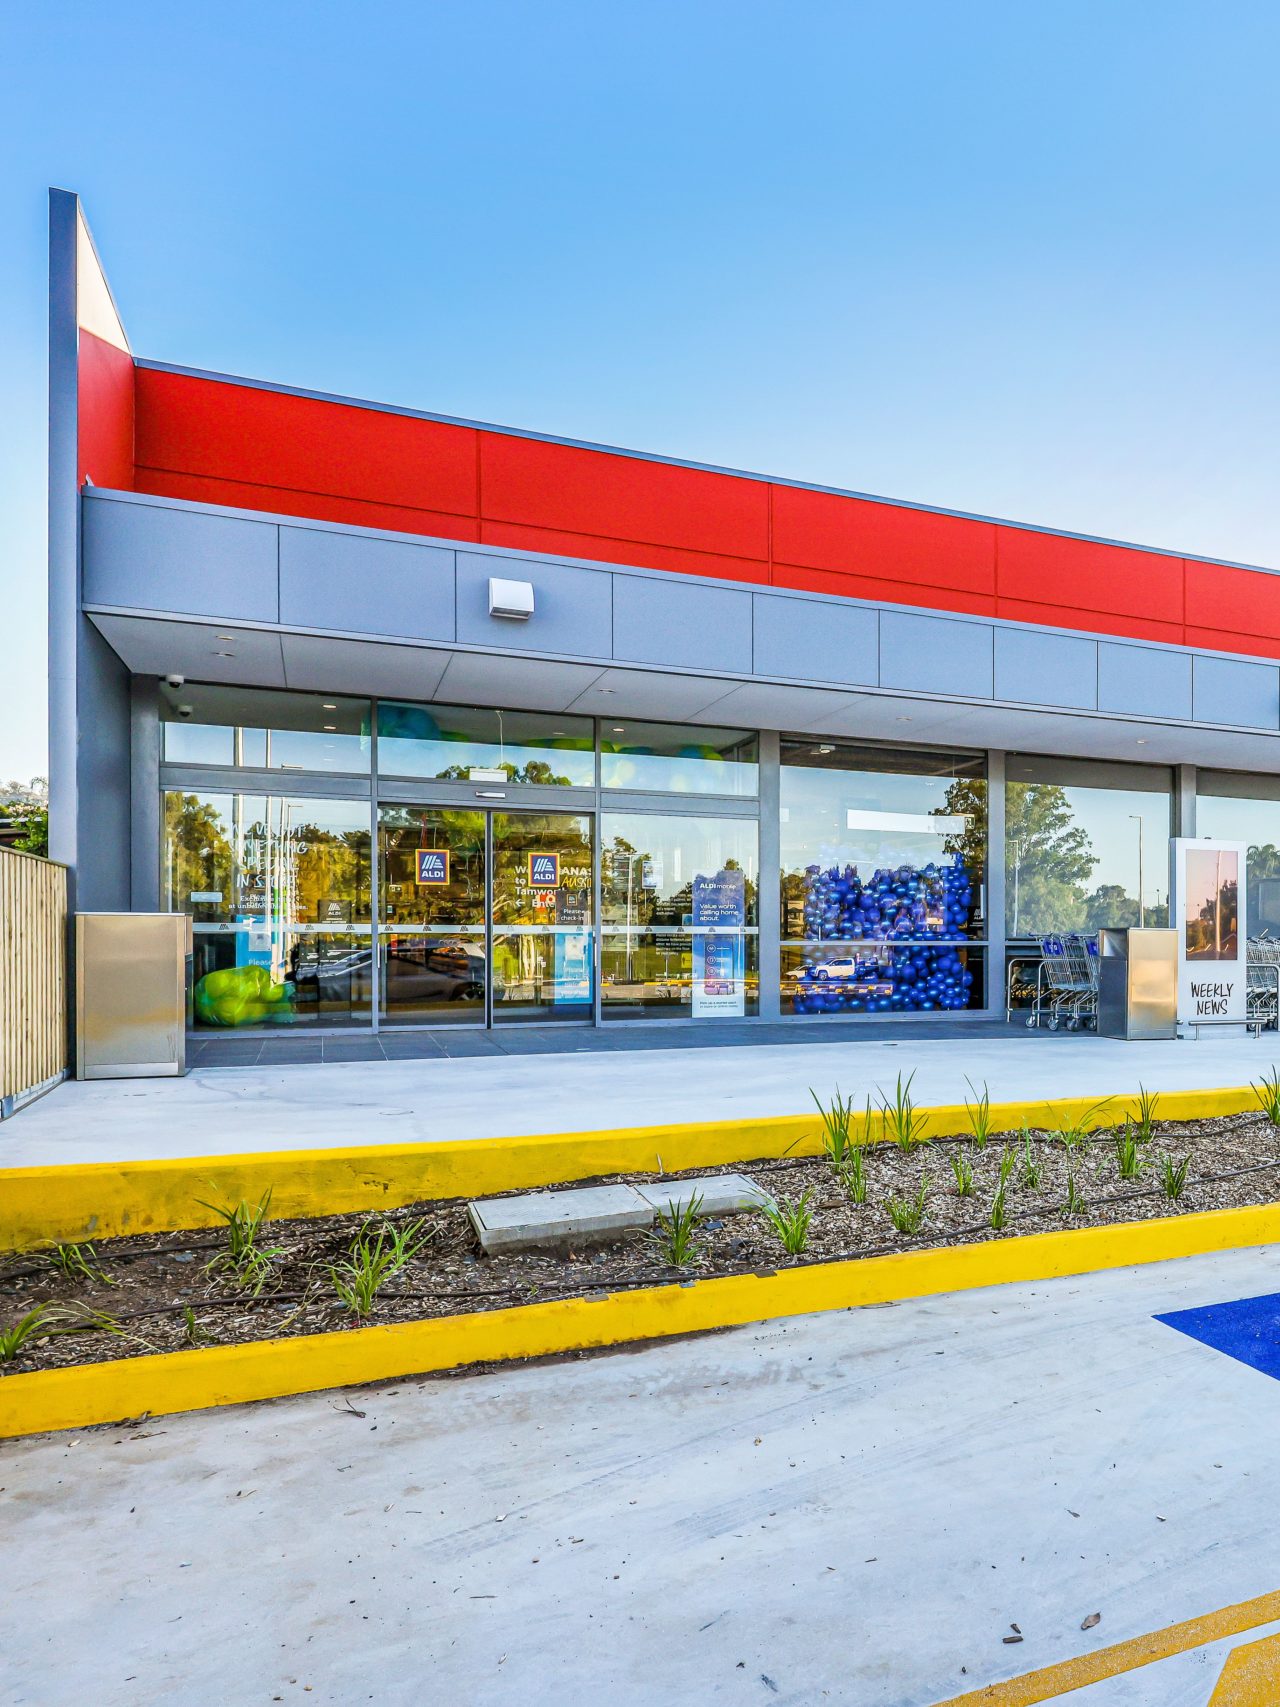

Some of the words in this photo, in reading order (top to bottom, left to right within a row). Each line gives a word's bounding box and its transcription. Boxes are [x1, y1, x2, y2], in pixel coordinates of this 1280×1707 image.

[421, 870, 444, 878] ALDI
[515, 887, 565, 895] Tamwor
[532, 899, 556, 908] Ente
[1191, 981, 1234, 998] WEEKLY
[1196, 999, 1228, 1016] NEWS
